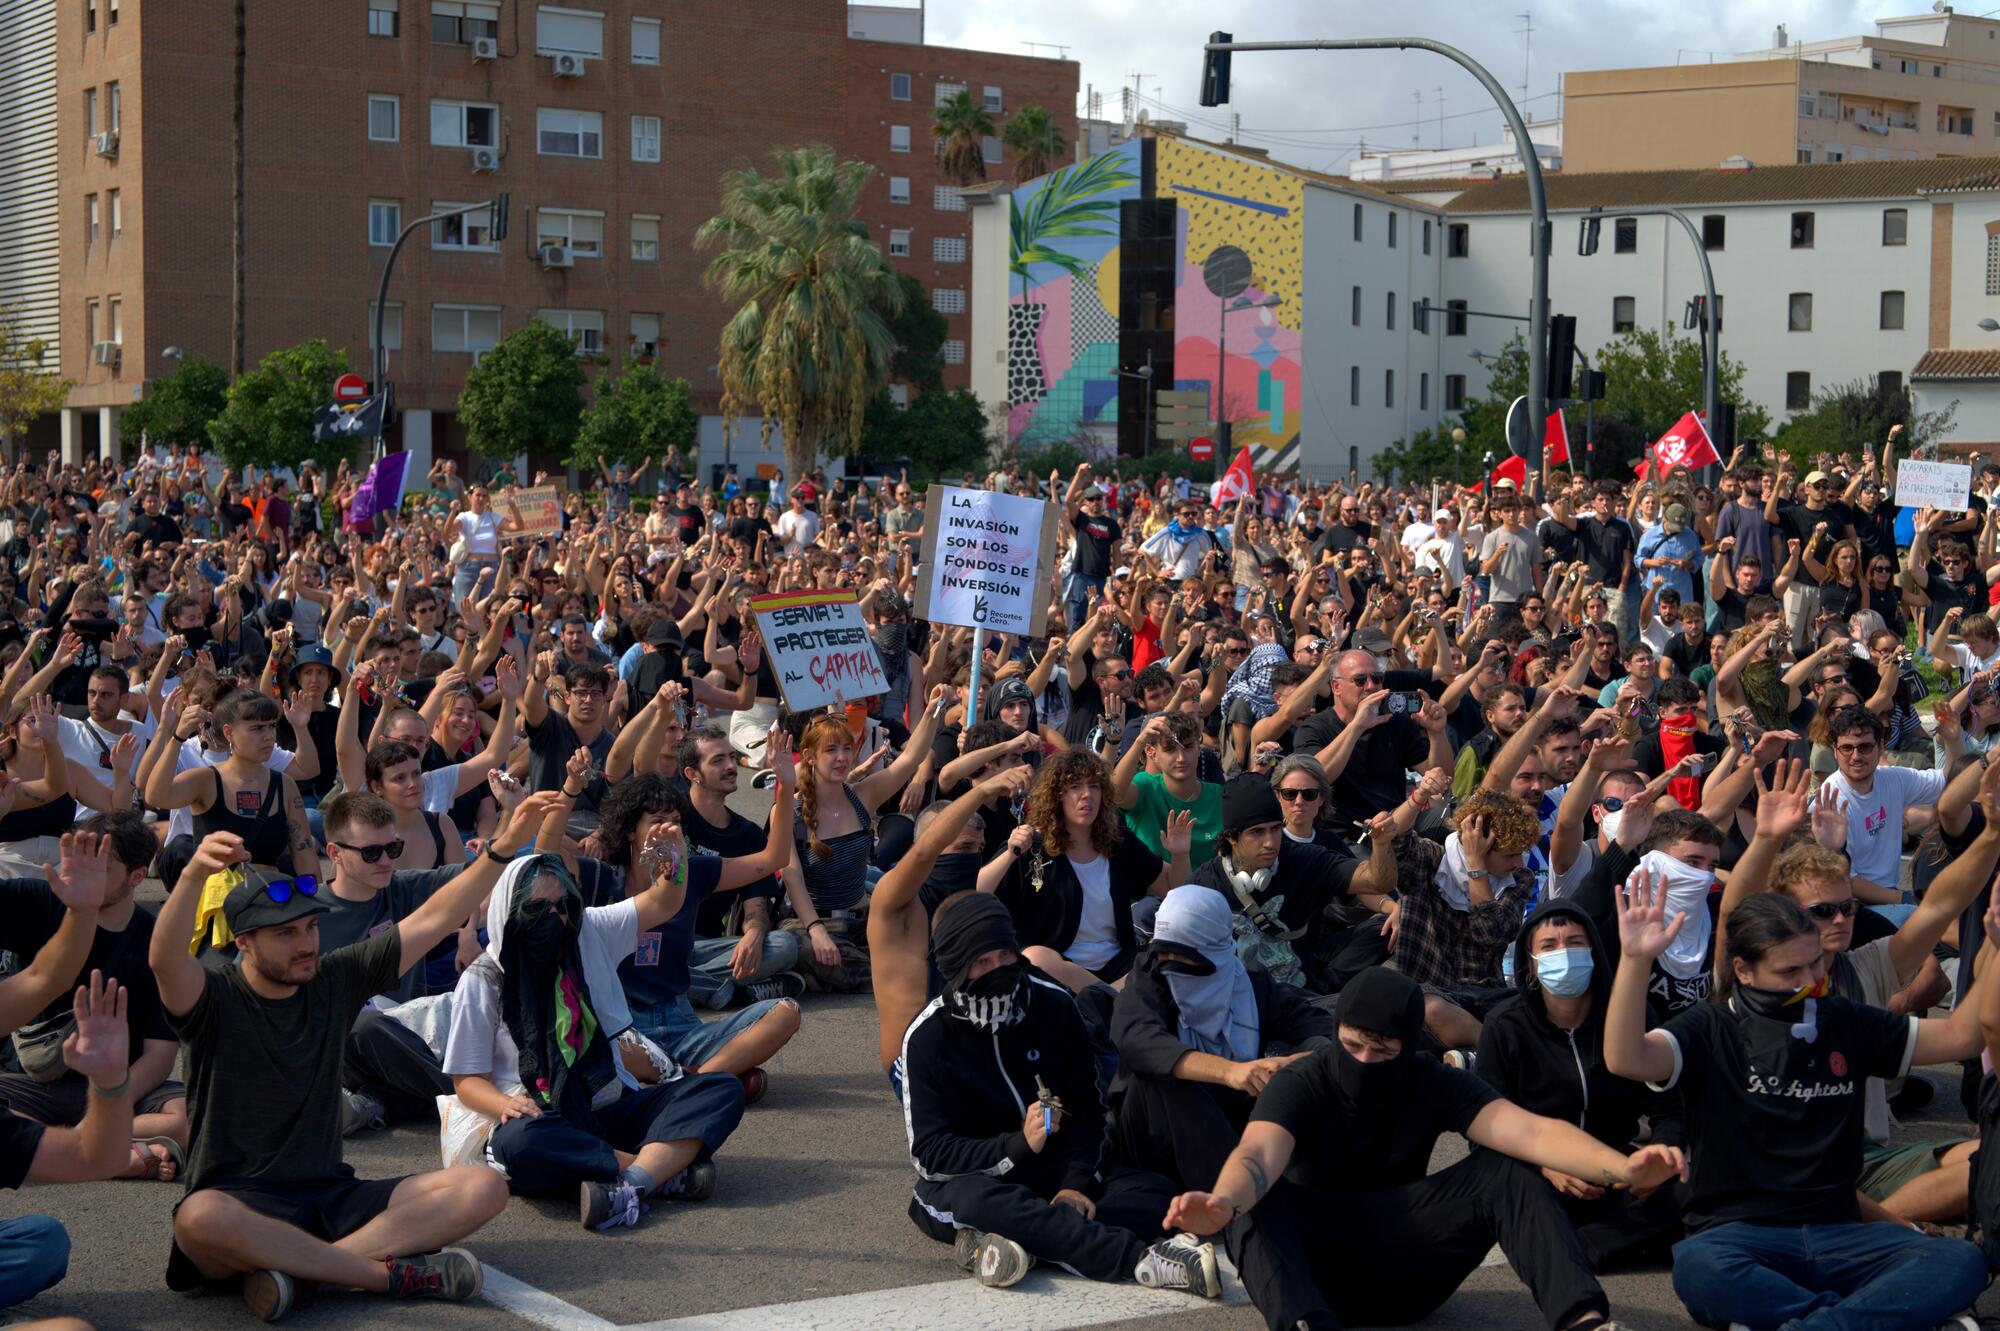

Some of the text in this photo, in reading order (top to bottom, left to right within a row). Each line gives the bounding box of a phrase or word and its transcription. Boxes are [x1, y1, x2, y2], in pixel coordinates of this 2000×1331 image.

[951, 495, 972, 509] LA
[949, 516, 1019, 536] INVASIÓN
[946, 536, 1009, 554] SON LOS
[1010, 565, 1030, 578] DE
[772, 604, 831, 628] SERVIR
[990, 610, 1023, 621] Recortes
[773, 627, 868, 655] PROTEGER
[785, 649, 882, 692] AL CAPITAL
